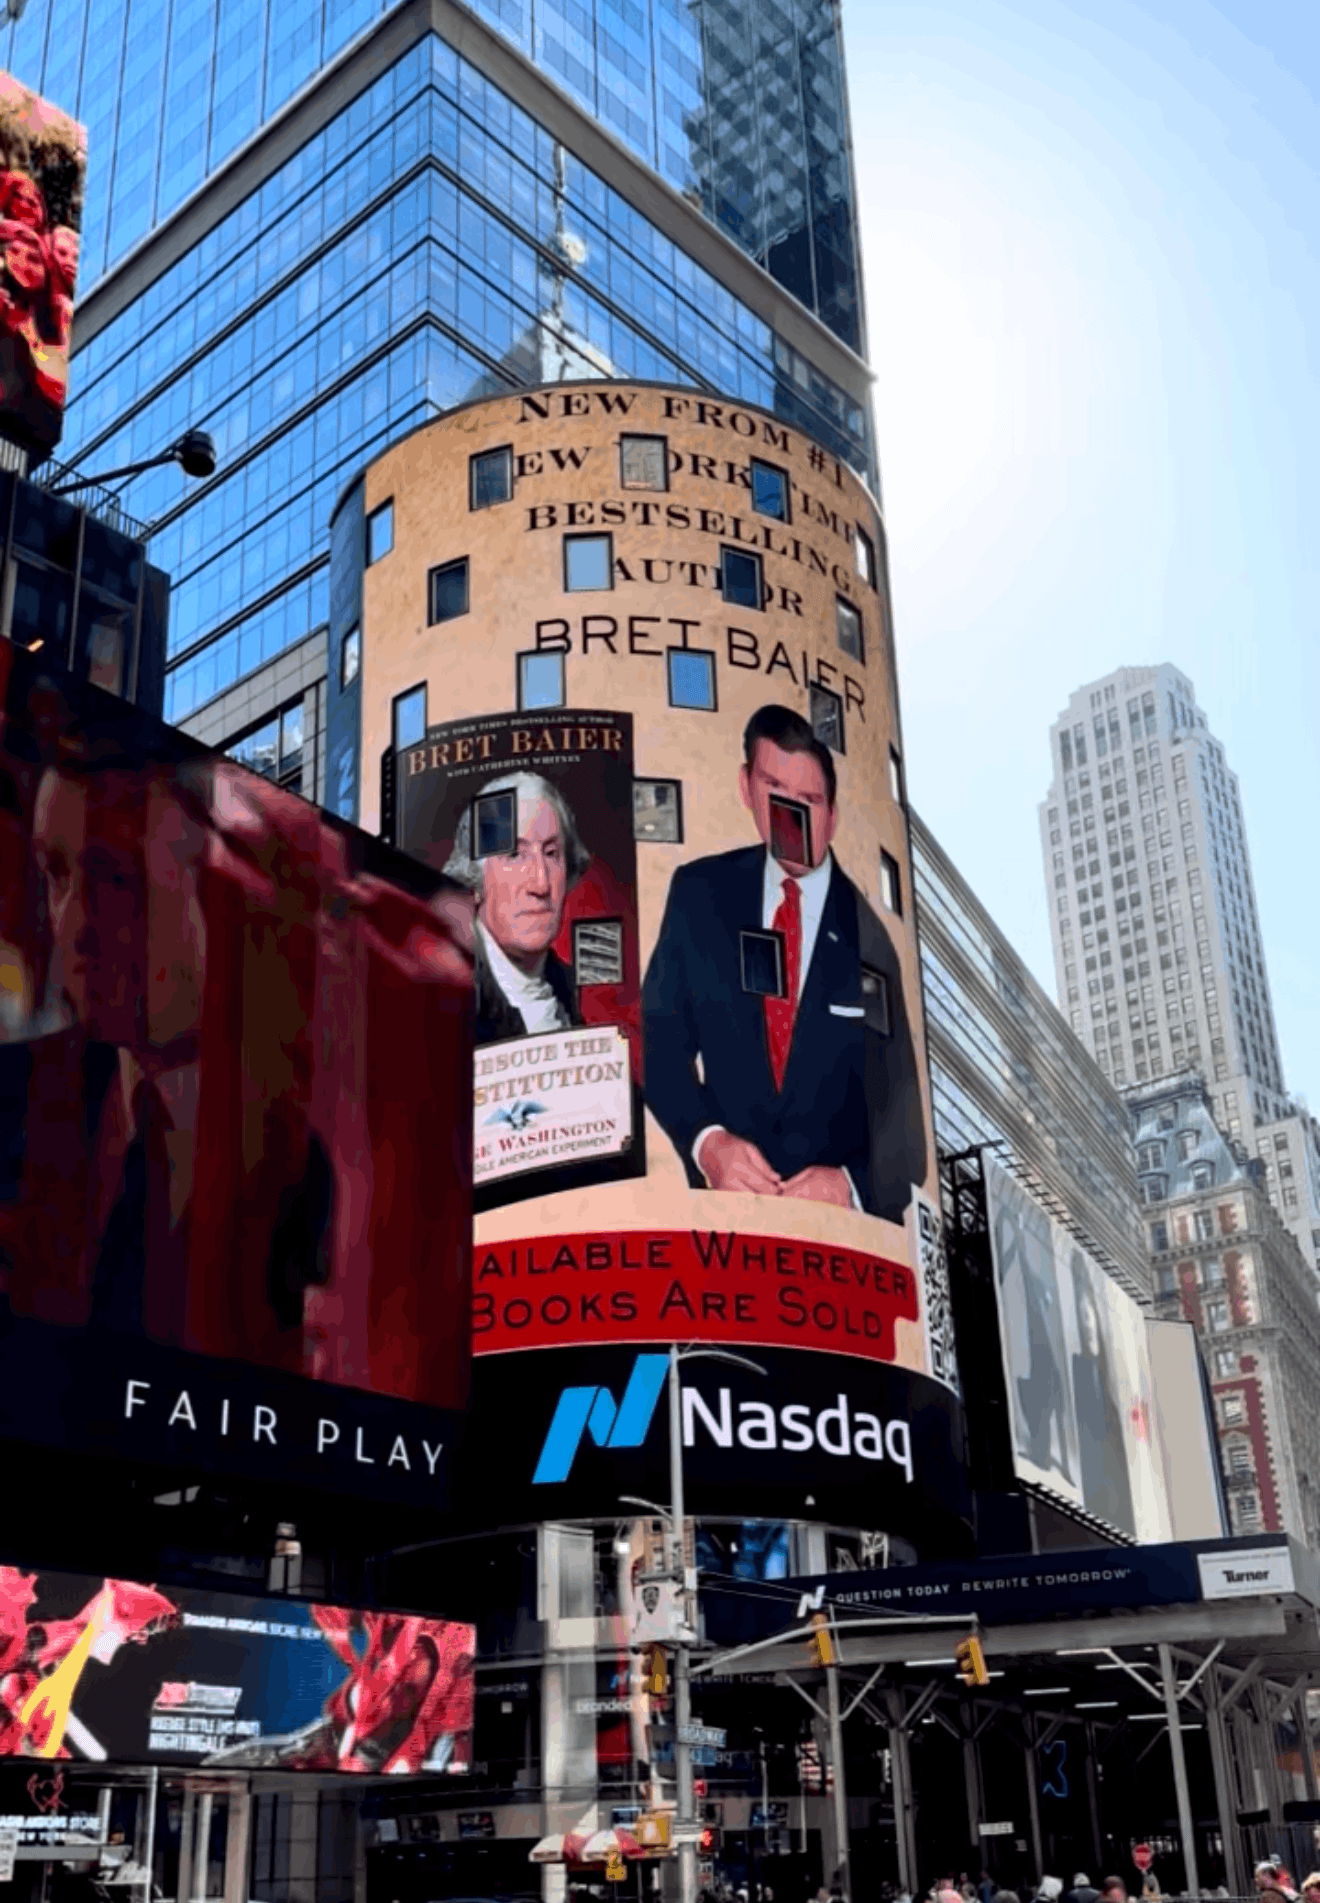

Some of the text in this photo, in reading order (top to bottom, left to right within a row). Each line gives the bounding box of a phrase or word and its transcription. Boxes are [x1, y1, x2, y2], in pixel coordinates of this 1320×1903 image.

[513, 445, 593, 484] EW
[514, 391, 845, 492] NEW FROM #1
[525, 500, 851, 592] BESTSELLING
[536, 614, 866, 724] BRET BAIER
[407, 727, 623, 777] BRET BAIER
[475, 1036, 613, 1076] ESCUE THE
[499, 1119, 616, 1150] WASHINGTON
[479, 1228, 909, 1301] AILABLE WHEREVER
[474, 1279, 883, 1340] BOOKS ARE SOLD
[125, 1379, 444, 1475] FAIR PLAY
[681, 1387, 914, 1484] Nasdaq
[836, 1589, 902, 1602] QUESTION
[907, 1584, 950, 1597] TODAY
[961, 1577, 1030, 1592] REWRITE
[1222, 1570, 1270, 1583] Turner
